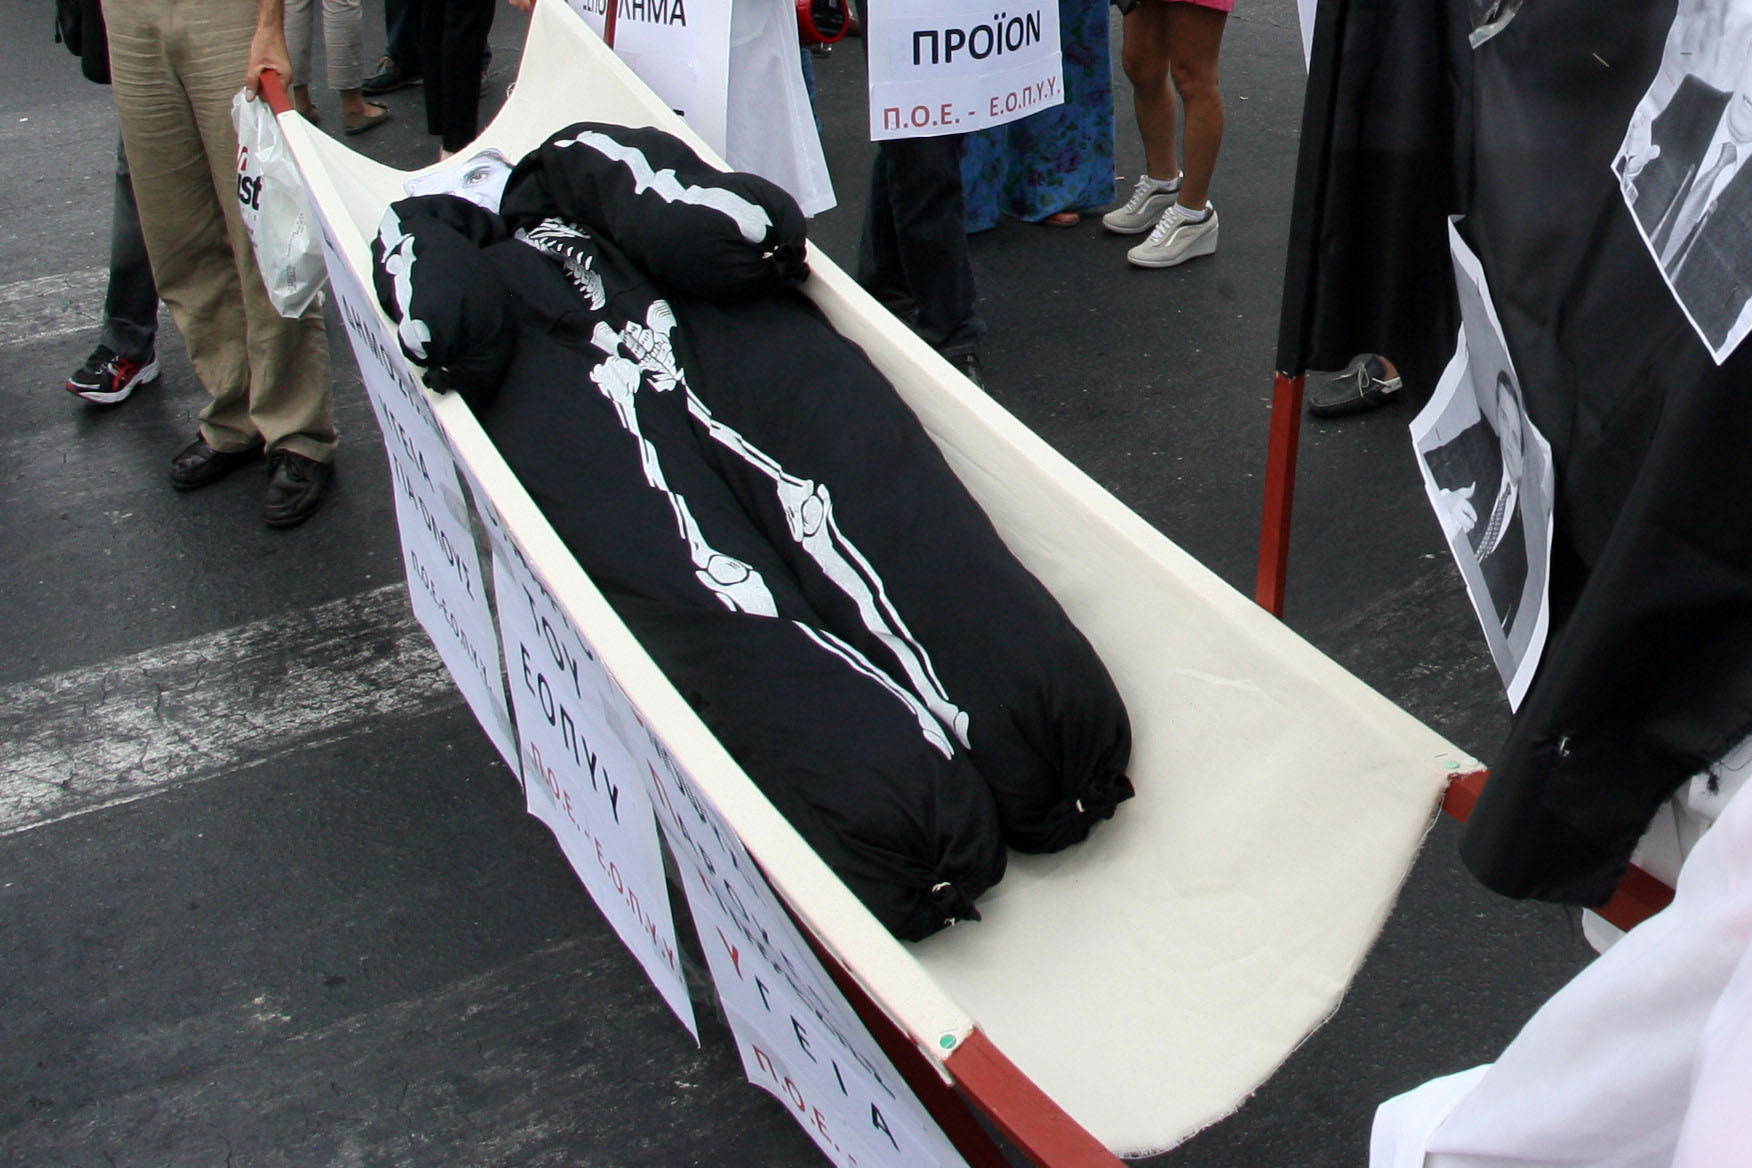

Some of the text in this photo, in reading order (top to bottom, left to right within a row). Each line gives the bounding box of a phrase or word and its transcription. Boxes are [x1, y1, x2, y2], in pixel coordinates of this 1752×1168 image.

[913, 10, 1041, 66] ΠΡΟΪΟΝ
[884, 103, 960, 130] Π.Ο.Ε.
[522, 584, 582, 699] ΤΟΥ
[520, 641, 619, 825] ΕΟΠΥΥ
